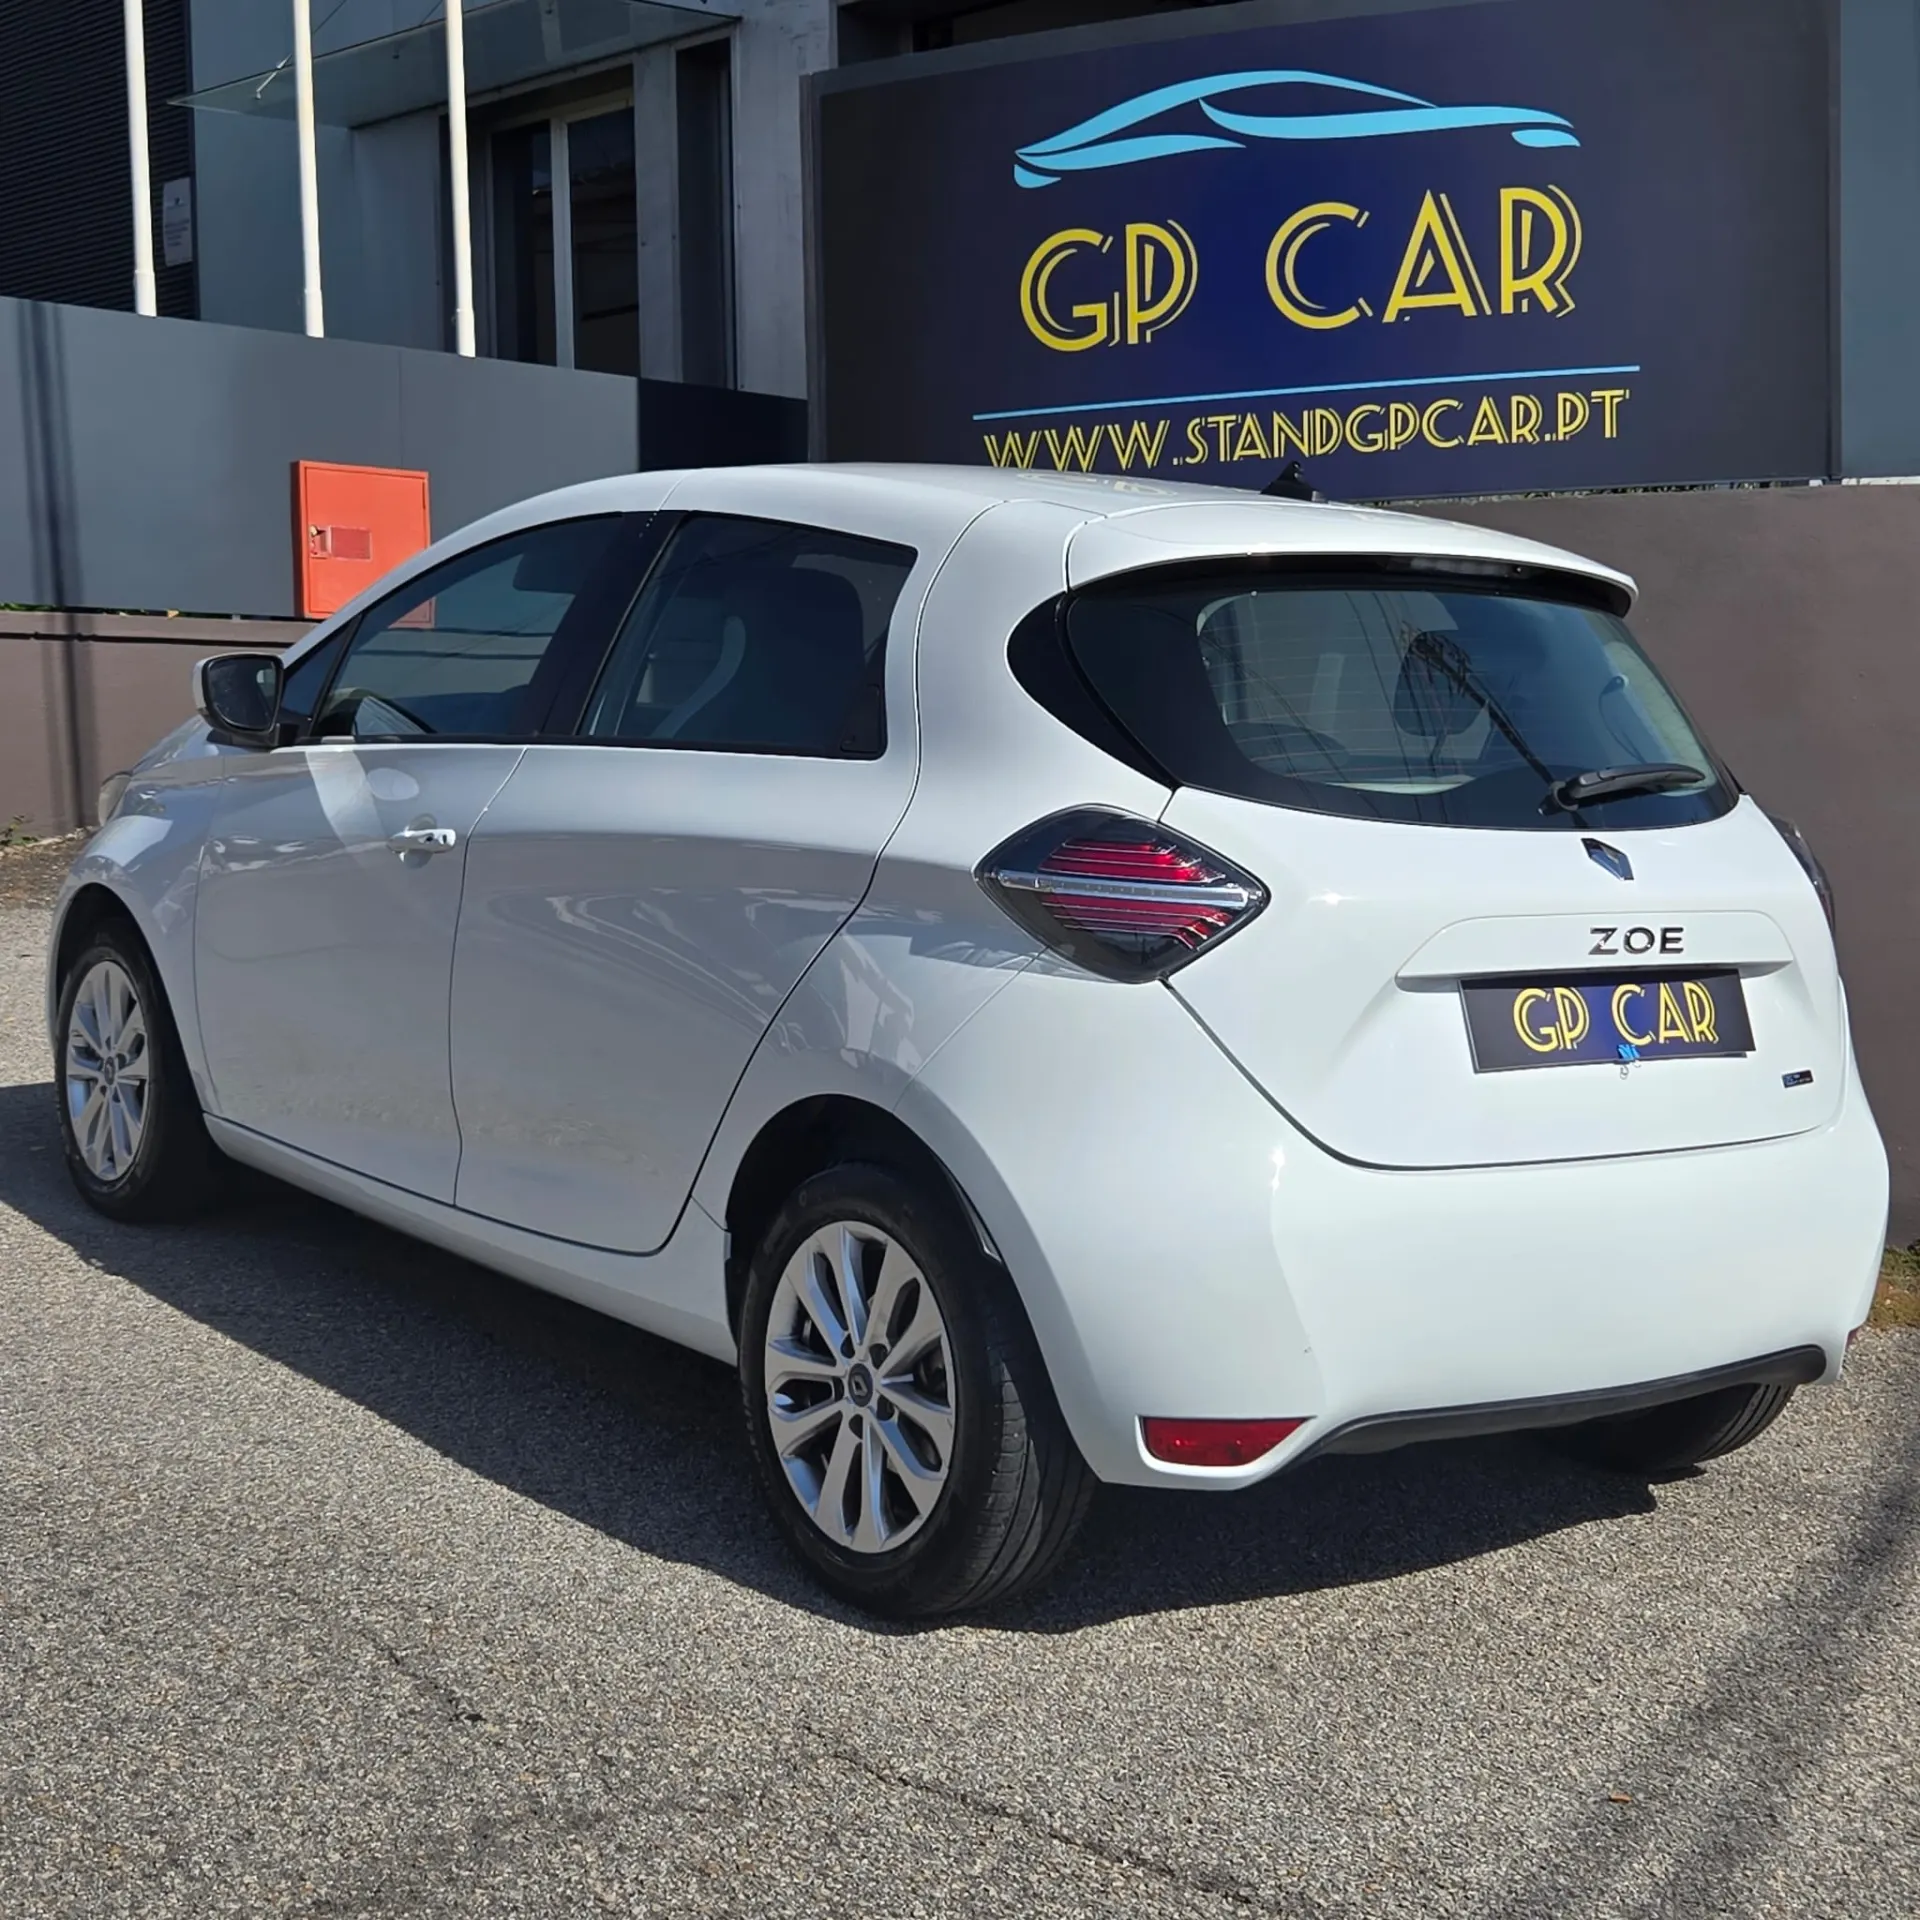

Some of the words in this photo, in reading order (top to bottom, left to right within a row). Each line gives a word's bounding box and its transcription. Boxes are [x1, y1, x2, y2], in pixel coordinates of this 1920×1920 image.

[1019, 220, 1198, 352] GP
[1265, 184, 1583, 330] CAR
[984, 388, 1631, 472] WWW.STANDGPCAR.PT
[1588, 926, 1684, 955] ZOE
[1512, 985, 1590, 1053] GP
[1611, 979, 1719, 1046] CAR
